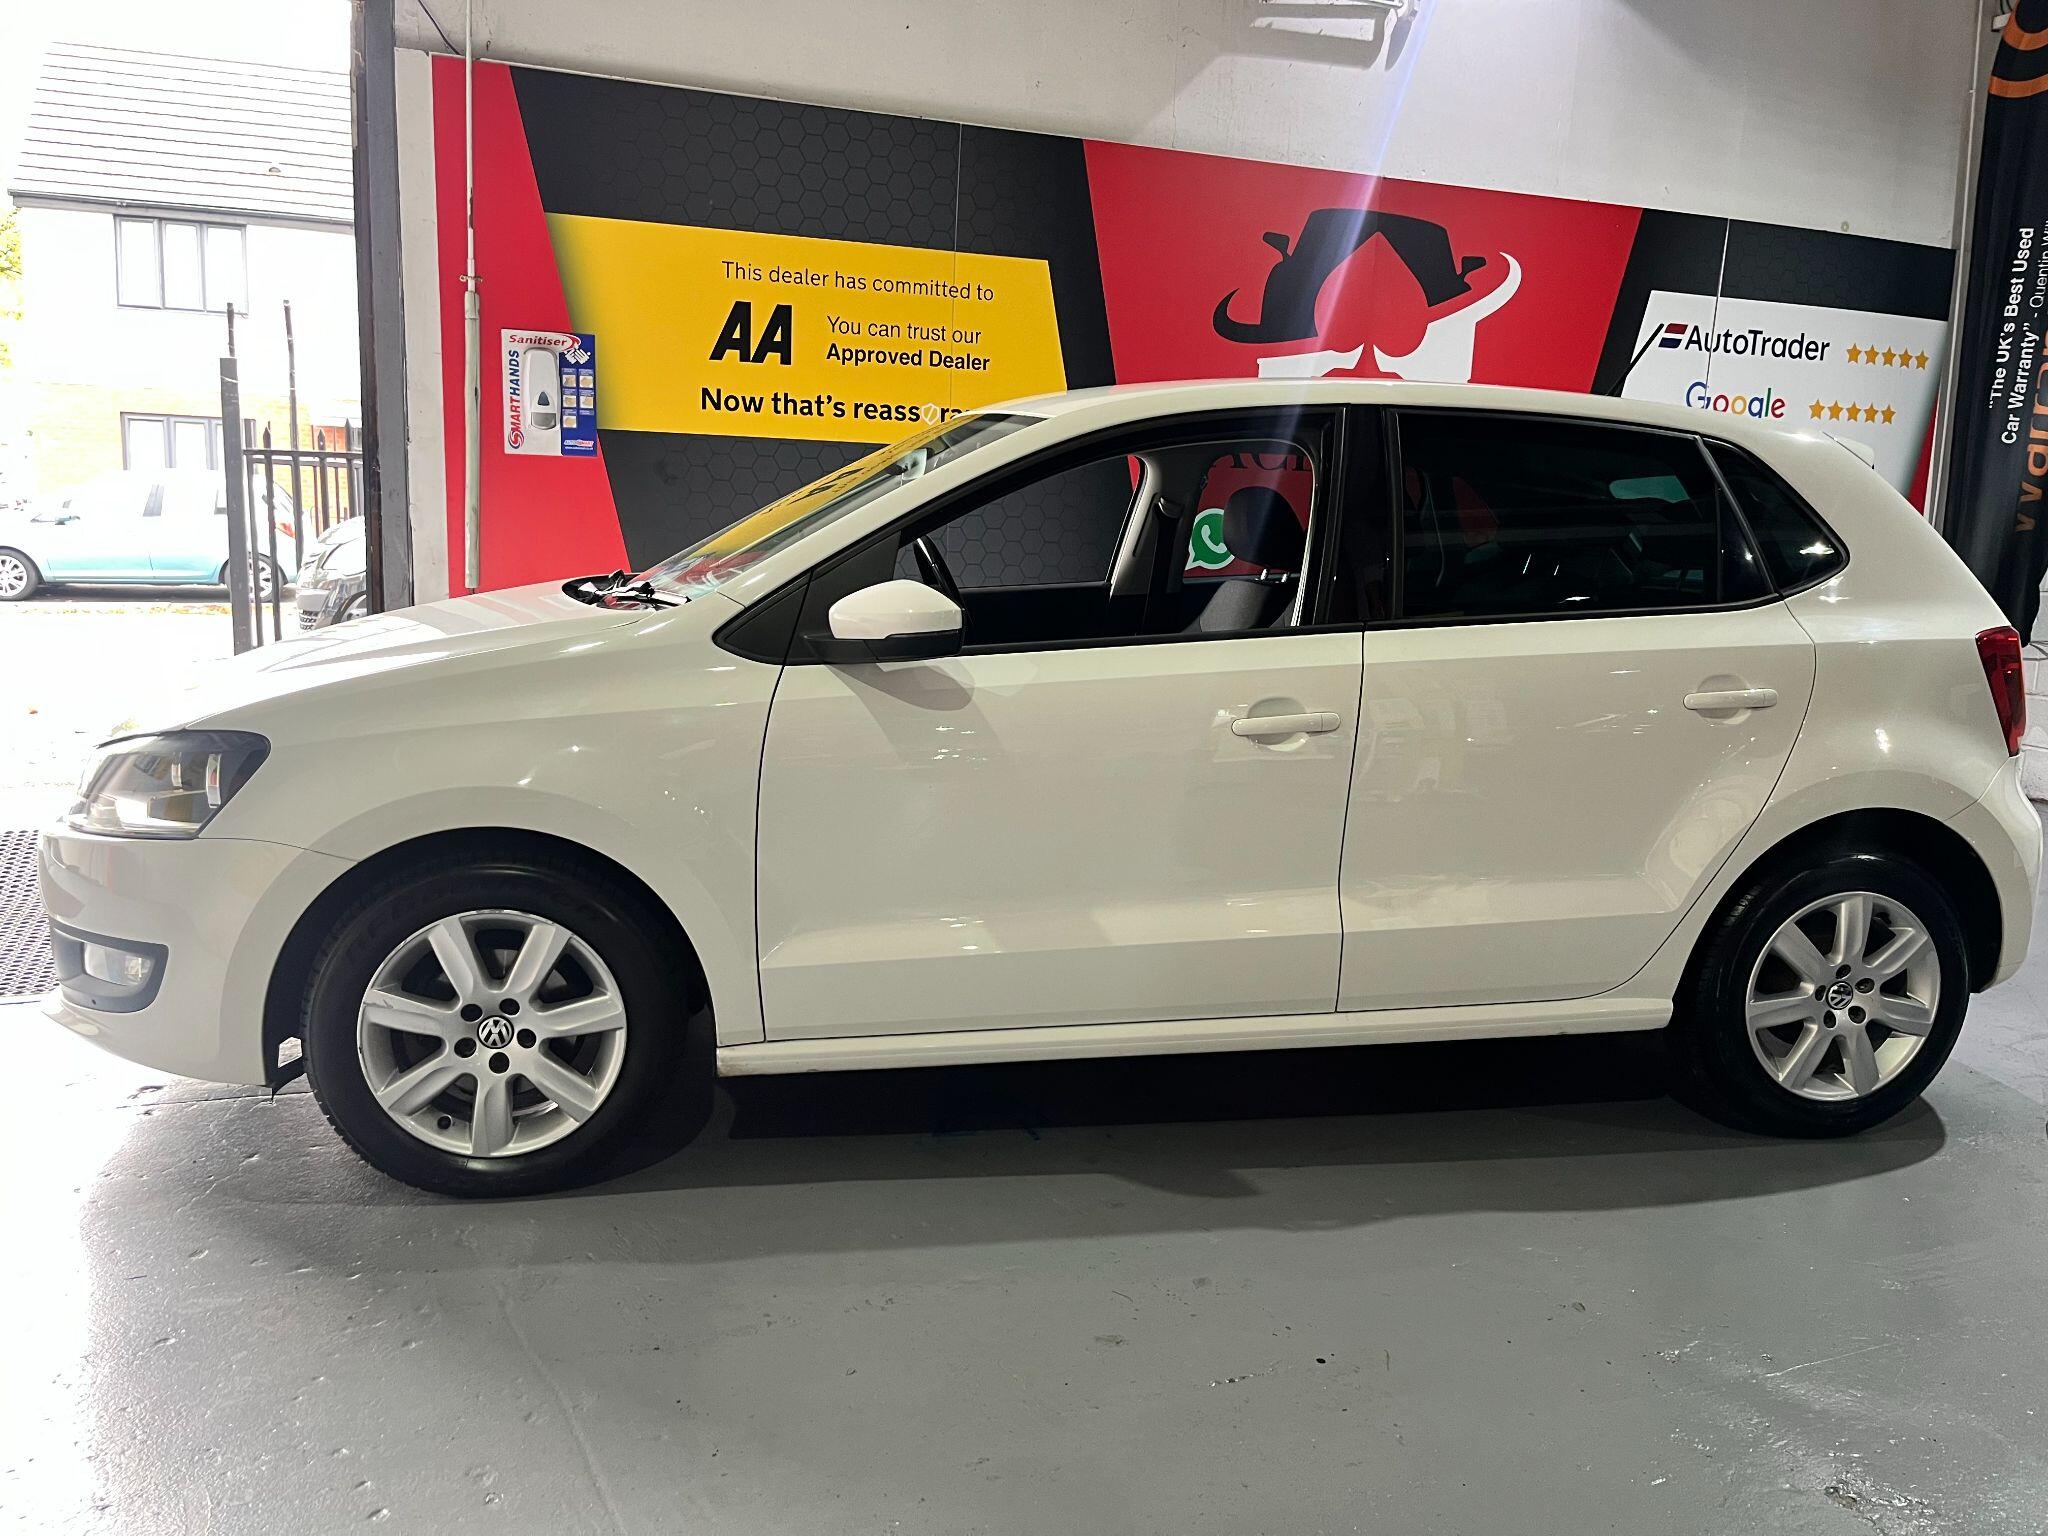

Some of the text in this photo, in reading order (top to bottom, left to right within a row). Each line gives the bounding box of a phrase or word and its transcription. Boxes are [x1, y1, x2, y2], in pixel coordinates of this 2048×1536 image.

[2011, 227, 2035, 272] Used
[722, 260, 994, 302] This dealer has committed to
[2003, 277, 2025, 317] Best
[508, 334, 568, 347] Sanitiser
[708, 299, 793, 366] AA
[827, 315, 982, 345] You can trust our
[1684, 324, 1830, 361] AutoTrader
[826, 342, 991, 372] Approved Dealer
[701, 387, 764, 414] Now
[771, 391, 846, 419] that’s
[1685, 381, 1786, 418] Google
[2001, 413, 2020, 444] Car
